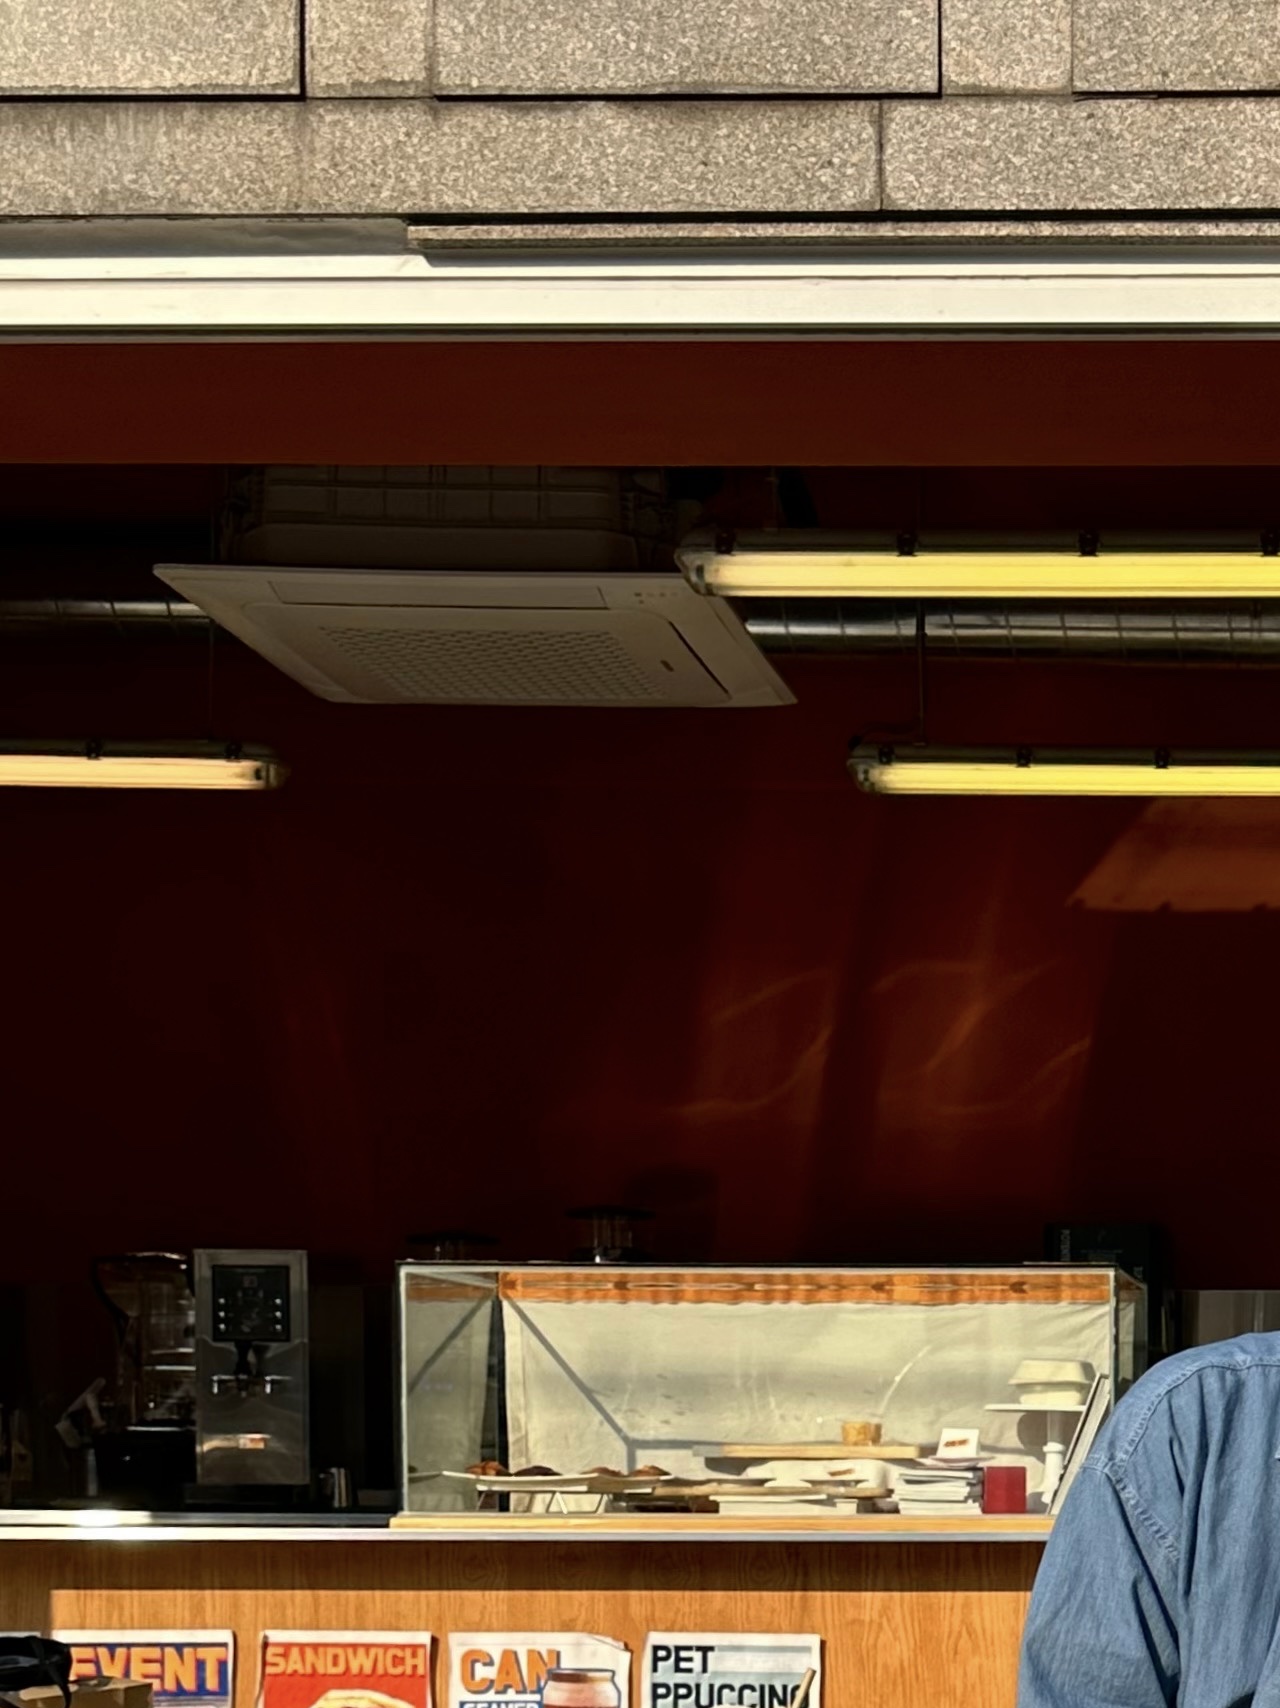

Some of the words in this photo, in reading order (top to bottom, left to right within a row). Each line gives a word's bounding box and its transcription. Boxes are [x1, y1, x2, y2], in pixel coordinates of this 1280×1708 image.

[69, 1646, 227, 1693] EVENT
[265, 1645, 426, 1676] SANDWICH
[460, 1648, 561, 1695] CAN
[651, 1644, 716, 1674] PET
